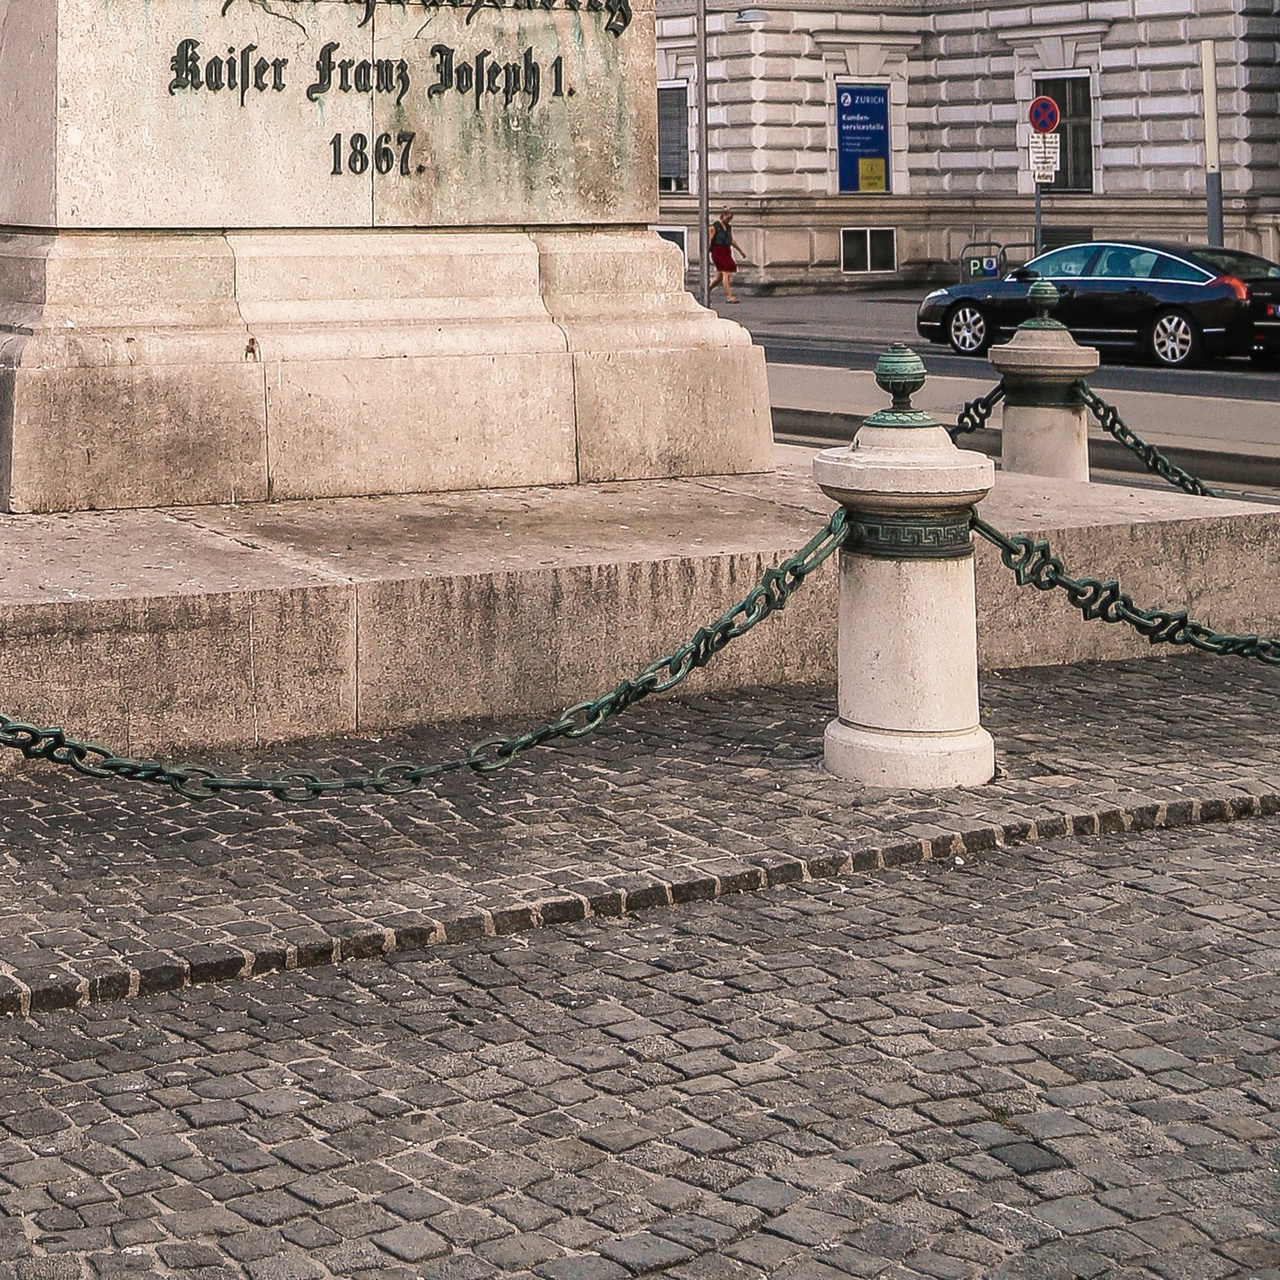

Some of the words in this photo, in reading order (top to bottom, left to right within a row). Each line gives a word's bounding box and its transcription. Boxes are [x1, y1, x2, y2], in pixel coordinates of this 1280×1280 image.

[307, 42, 409, 105] Franz
[854, 95, 885, 105] ZURICH
[329, 131, 425, 175] 1867.
